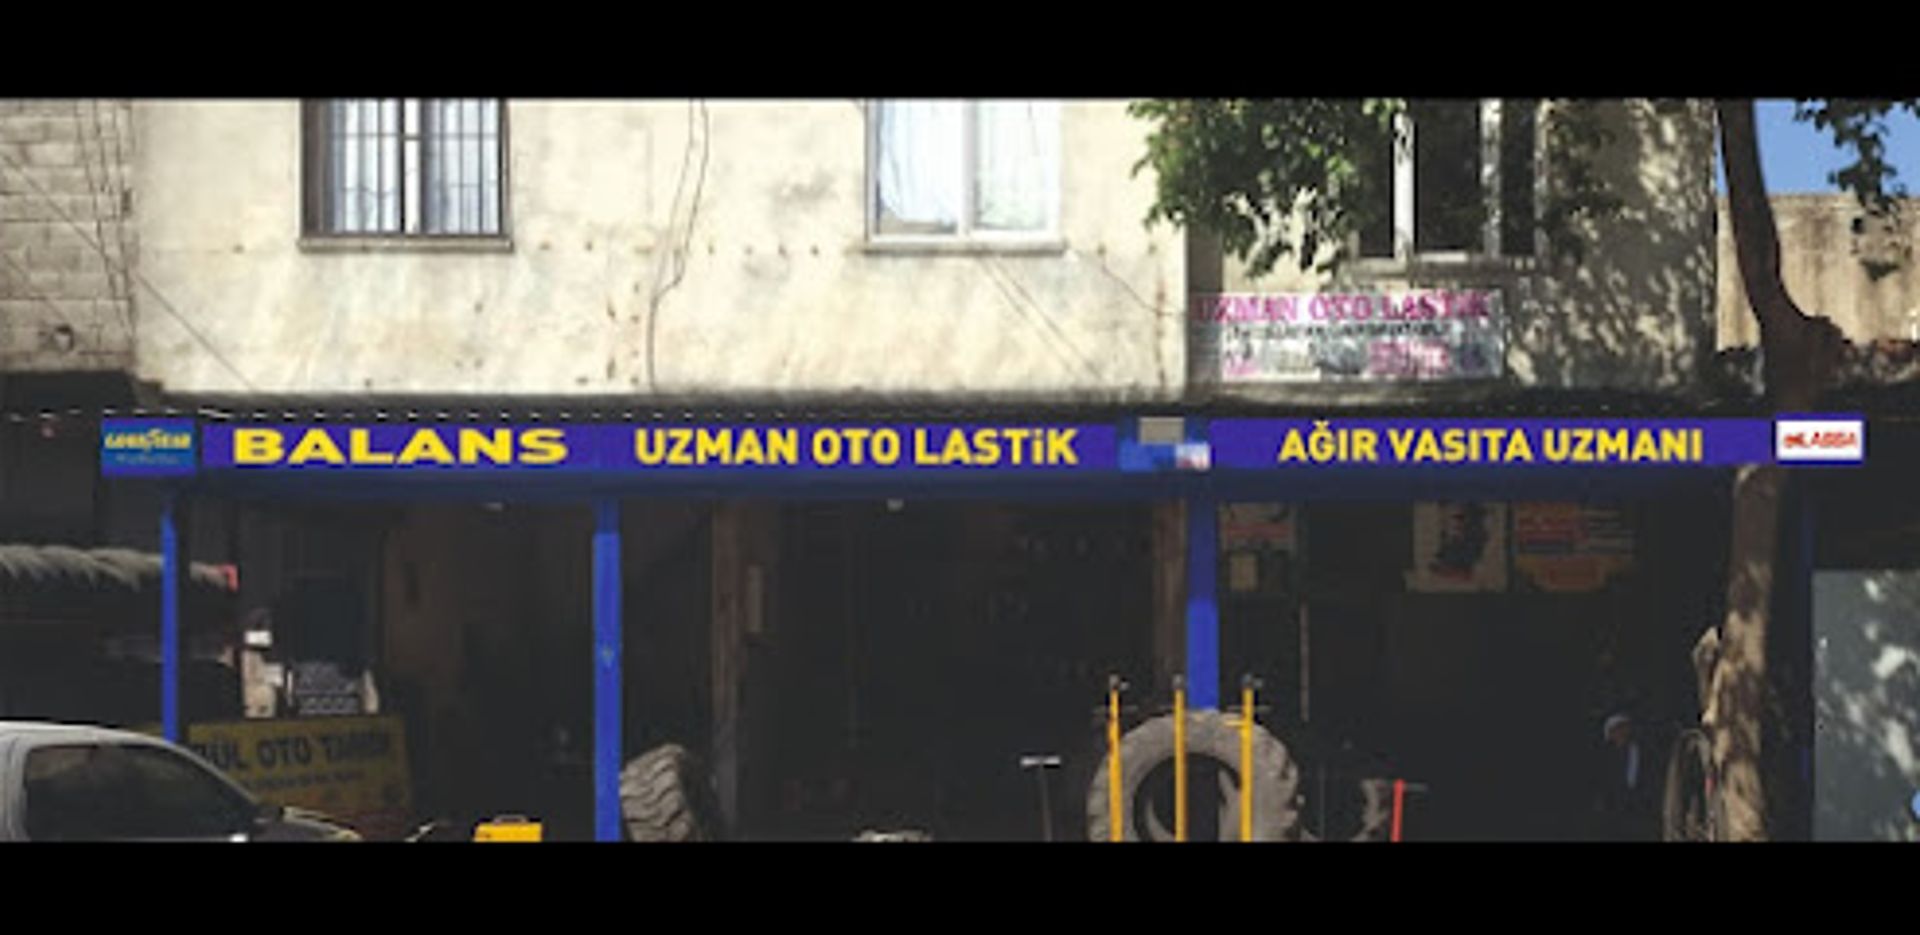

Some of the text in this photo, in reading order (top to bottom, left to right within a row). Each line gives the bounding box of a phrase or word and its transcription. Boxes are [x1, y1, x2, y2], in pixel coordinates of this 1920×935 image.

[1308, 294, 1373, 321] OTO
[234, 428, 568, 463] BALANS
[635, 428, 798, 464] UZMAN
[813, 428, 900, 464] OTO
[1279, 421, 1702, 461] AĞIR VASITA UZMANI
